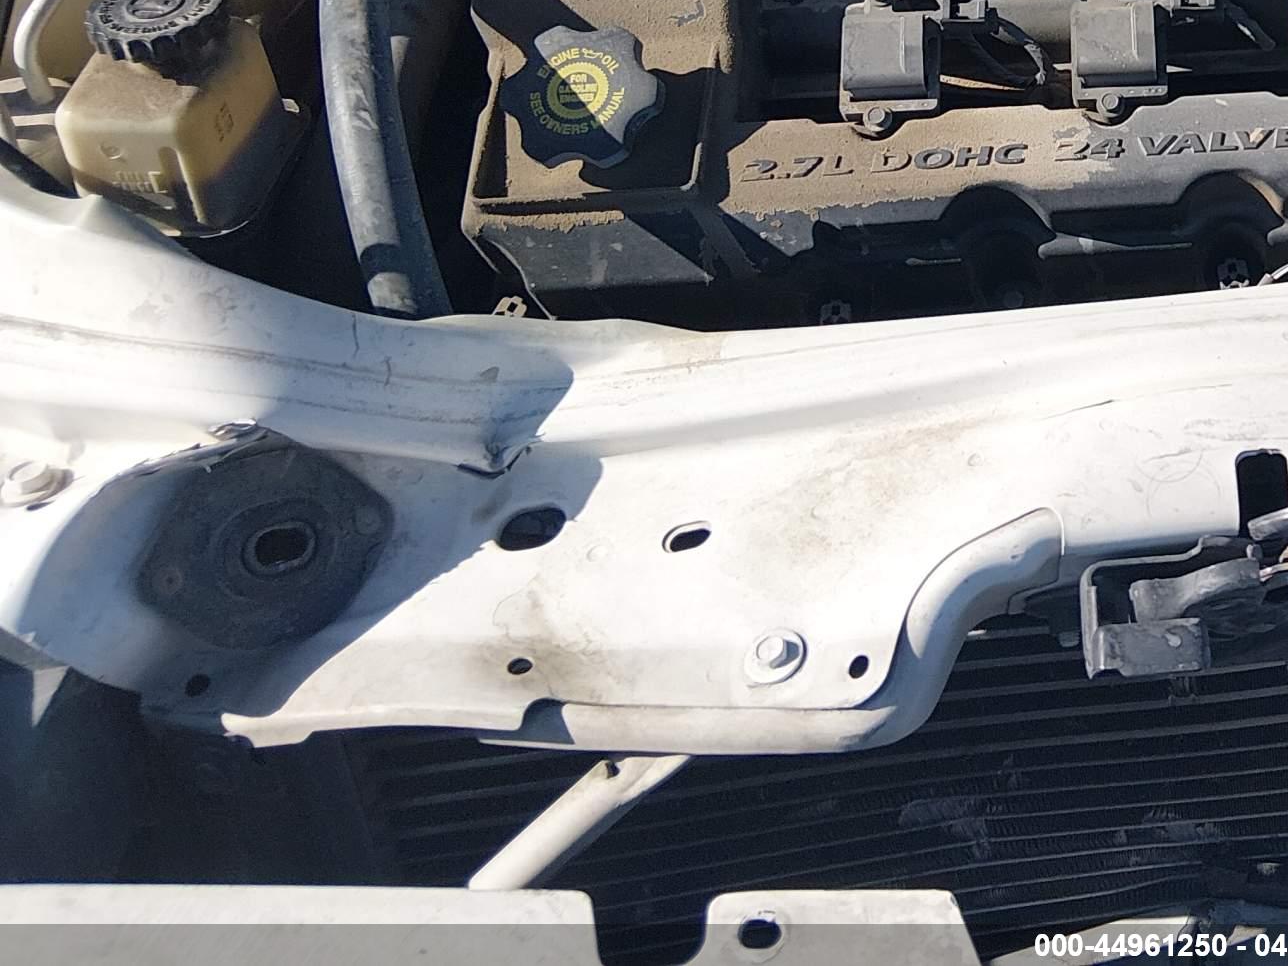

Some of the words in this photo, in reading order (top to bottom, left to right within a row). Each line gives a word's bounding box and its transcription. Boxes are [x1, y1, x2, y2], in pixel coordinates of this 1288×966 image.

[537, 47, 581, 79] ENGINE
[601, 55, 620, 75] OIL
[570, 74, 588, 83] FOR
[529, 91, 546, 117] SEE
[590, 87, 625, 130] MANUAL
[741, 154, 853, 183] 2.7L
[869, 143, 1029, 173] DOHC
[1054, 137, 1126, 161] 24
